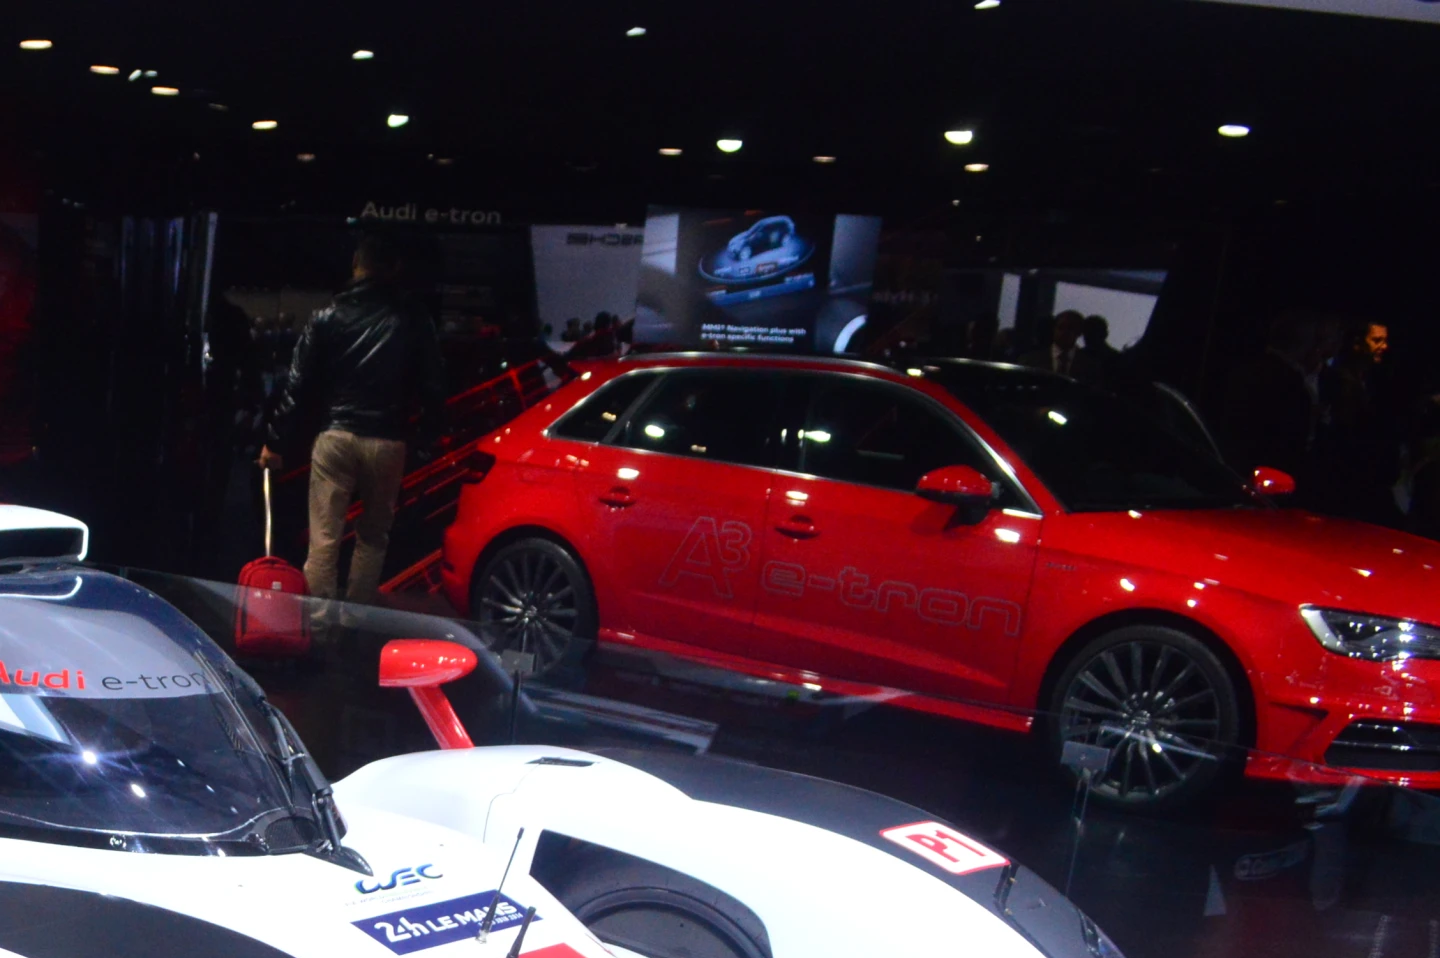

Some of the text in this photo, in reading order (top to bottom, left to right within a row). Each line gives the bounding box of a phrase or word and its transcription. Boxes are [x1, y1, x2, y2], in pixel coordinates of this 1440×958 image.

[361, 201, 502, 225] Audi e-tron
[701, 332, 795, 344] e-tron specific functions
[726, 324, 769, 335] Navigation
[770, 326, 787, 335] plus
[788, 328, 807, 336] with
[658, 515, 1022, 638] A3 e-tron
[101, 670, 207, 692] e-tron
[904, 829, 988, 863] P1
[354, 863, 444, 895] WEC
[426, 915, 460, 933] LE
